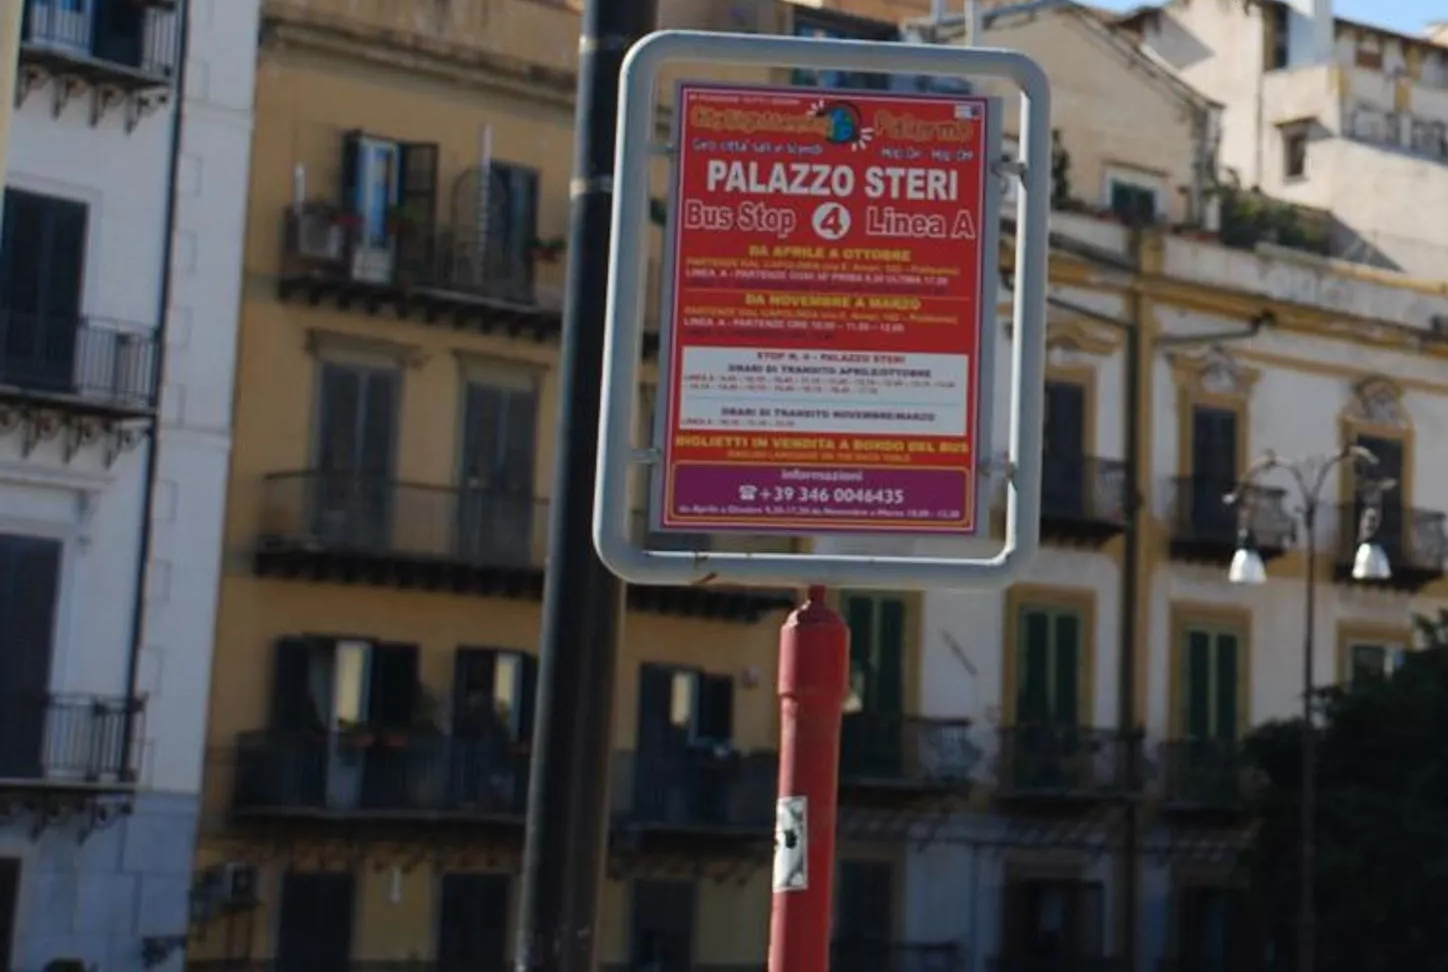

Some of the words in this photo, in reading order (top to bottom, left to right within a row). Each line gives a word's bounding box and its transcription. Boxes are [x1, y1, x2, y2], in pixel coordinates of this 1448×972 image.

[707, 159, 855, 197] PALAZZO
[864, 166, 959, 202] STERI
[684, 198, 733, 230] Bus
[737, 200, 796, 239] Stop
[818, 205, 844, 237] 4
[866, 205, 946, 238] Linea
[950, 208, 976, 240] A
[748, 244, 769, 257] DA
[772, 245, 825, 259] APRILE
[828, 248, 840, 259] A
[842, 248, 911, 262] OTTOBRE
[745, 293, 766, 305] DA
[769, 293, 849, 308] NOVEMBRE
[855, 297, 866, 308] A
[868, 297, 922, 311] MARZO
[676, 435, 748, 448] BIGLIETTI
[752, 436, 768, 448] IN
[771, 437, 835, 450] VENDITA
[838, 439, 849, 450] A
[852, 439, 904, 452] BORDO
[908, 441, 936, 452] DEL
[939, 441, 969, 453] BUS
[798, 486, 830, 503] 346
[834, 487, 904, 504] 0046435
